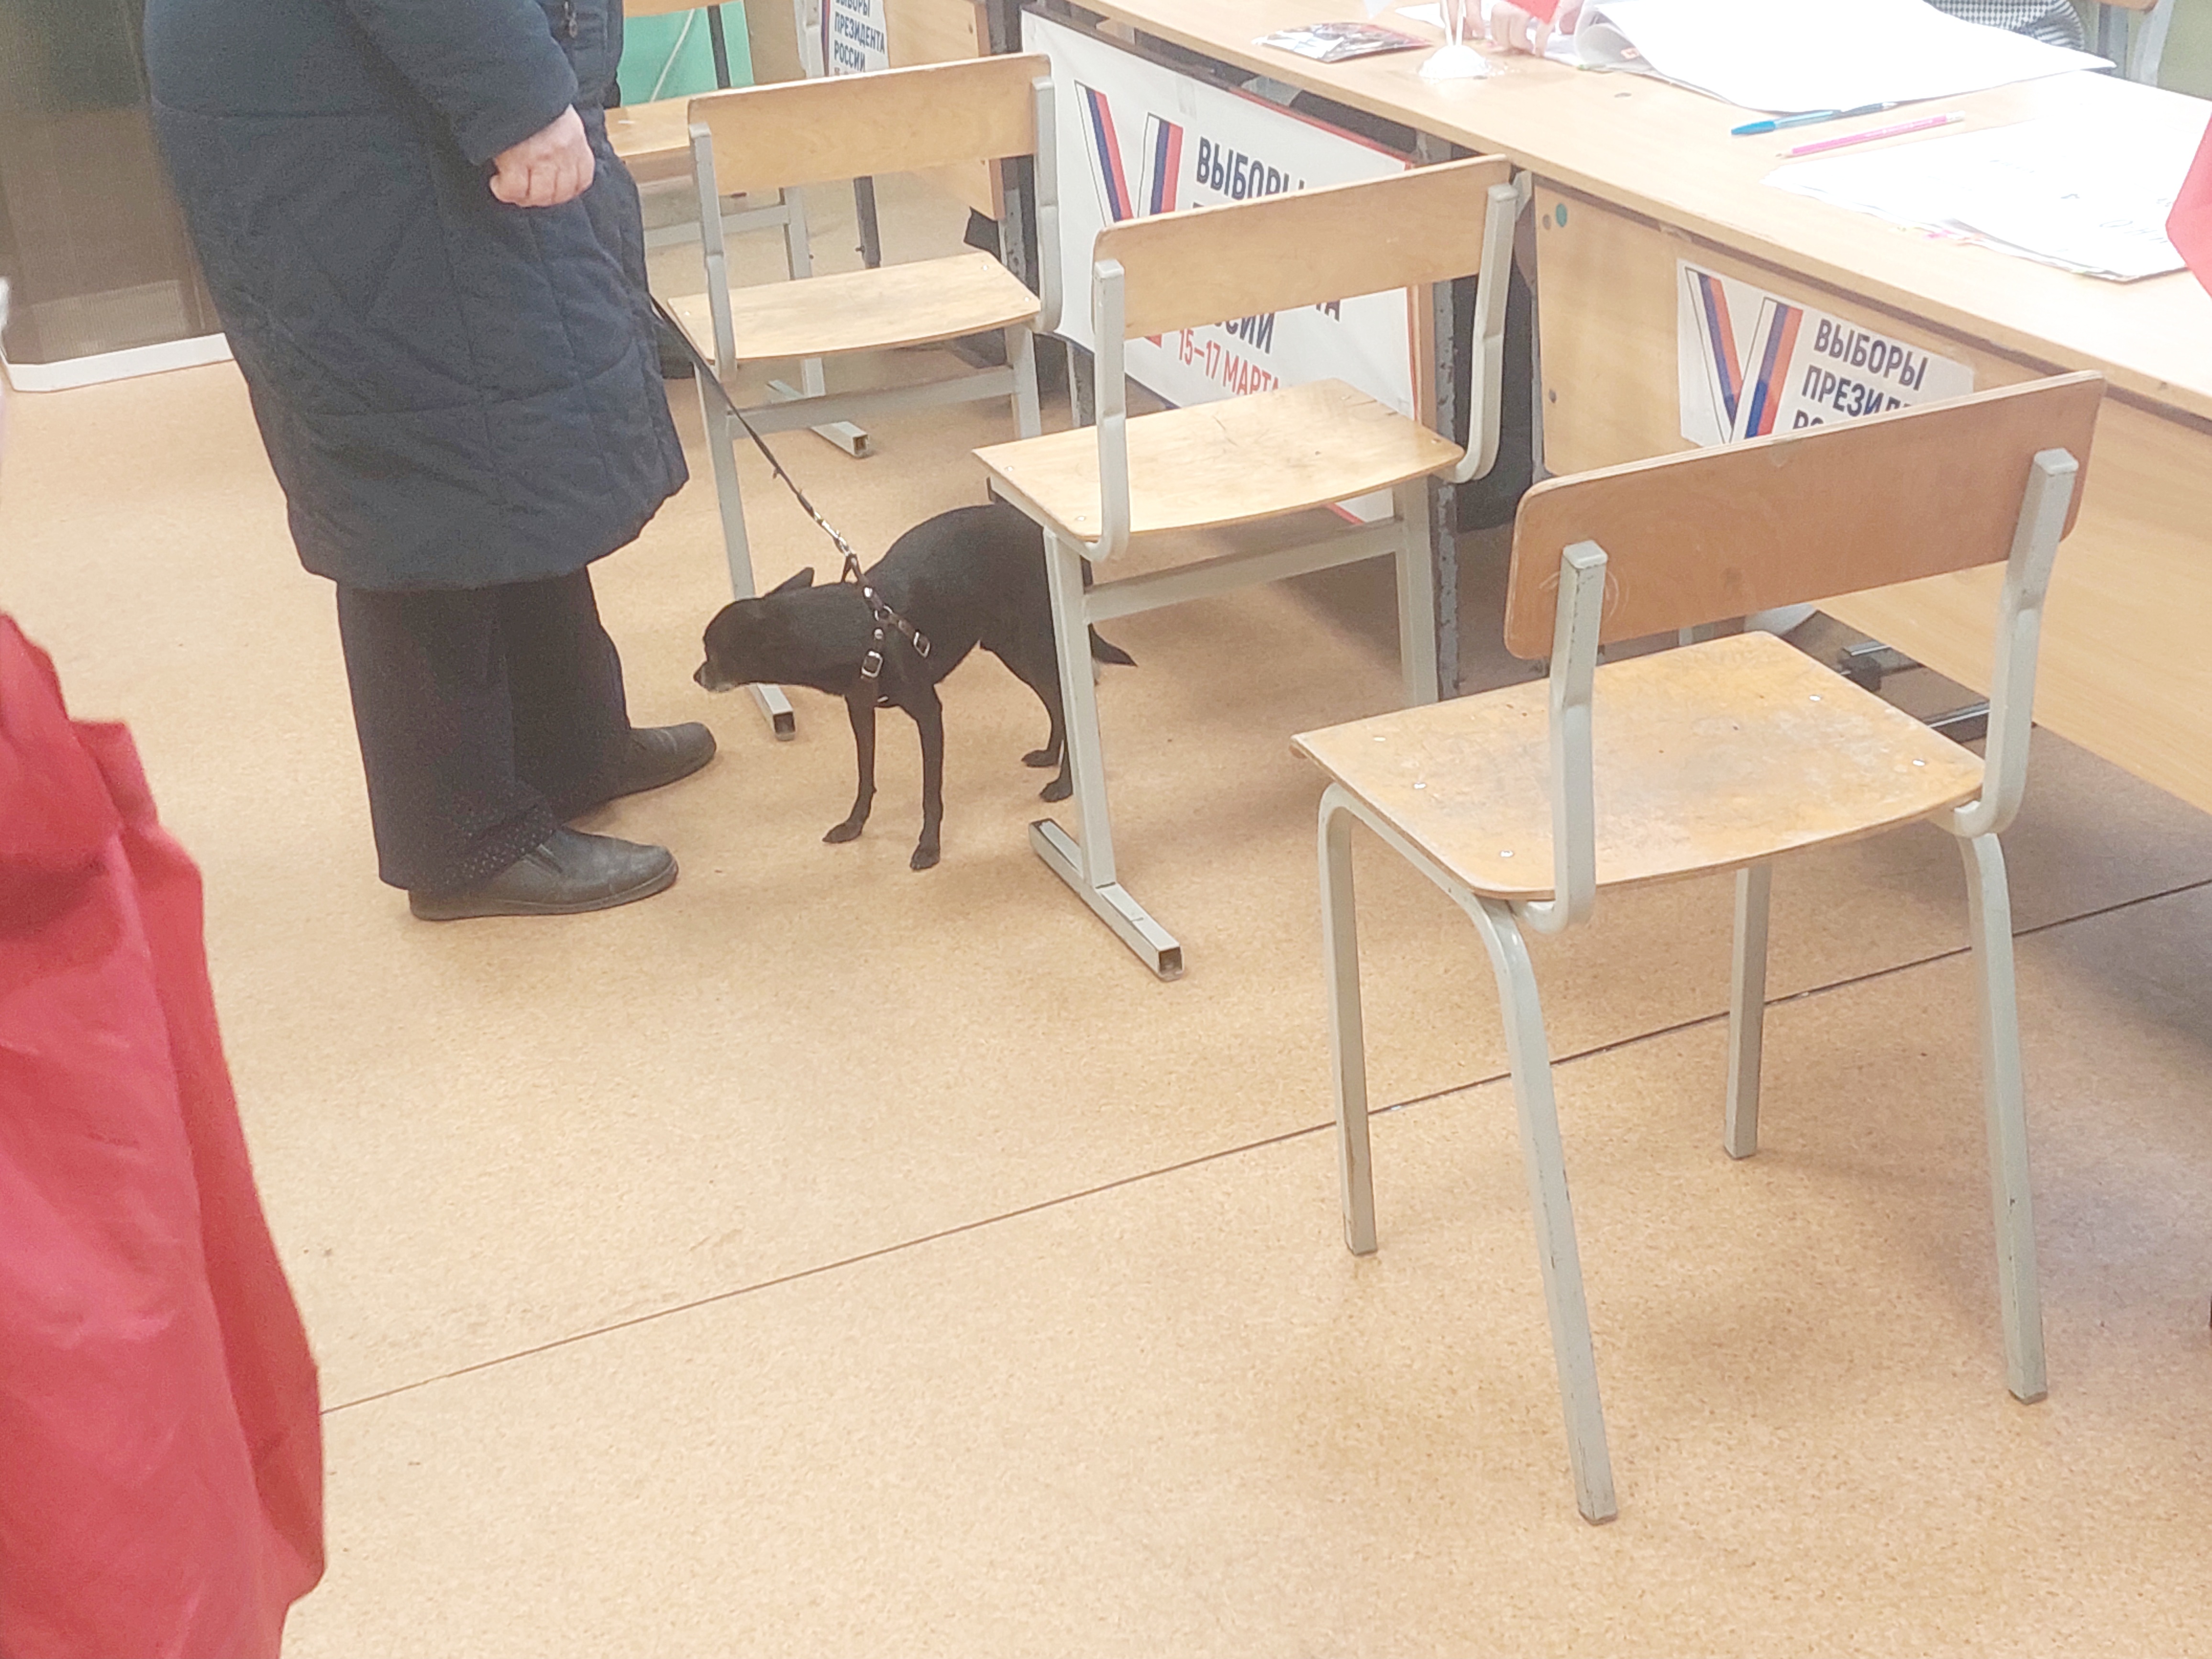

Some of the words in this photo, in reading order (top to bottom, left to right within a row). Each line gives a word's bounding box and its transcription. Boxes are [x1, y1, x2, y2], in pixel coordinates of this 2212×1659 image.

[834, 40, 865, 72] РОССИИ
[835, 11, 885, 54] ПРЕЗИДЕНТА
[1814, 319, 1928, 390] ВЫБОРЫ
[1802, 365, 1911, 417] ПРЕЗИ
